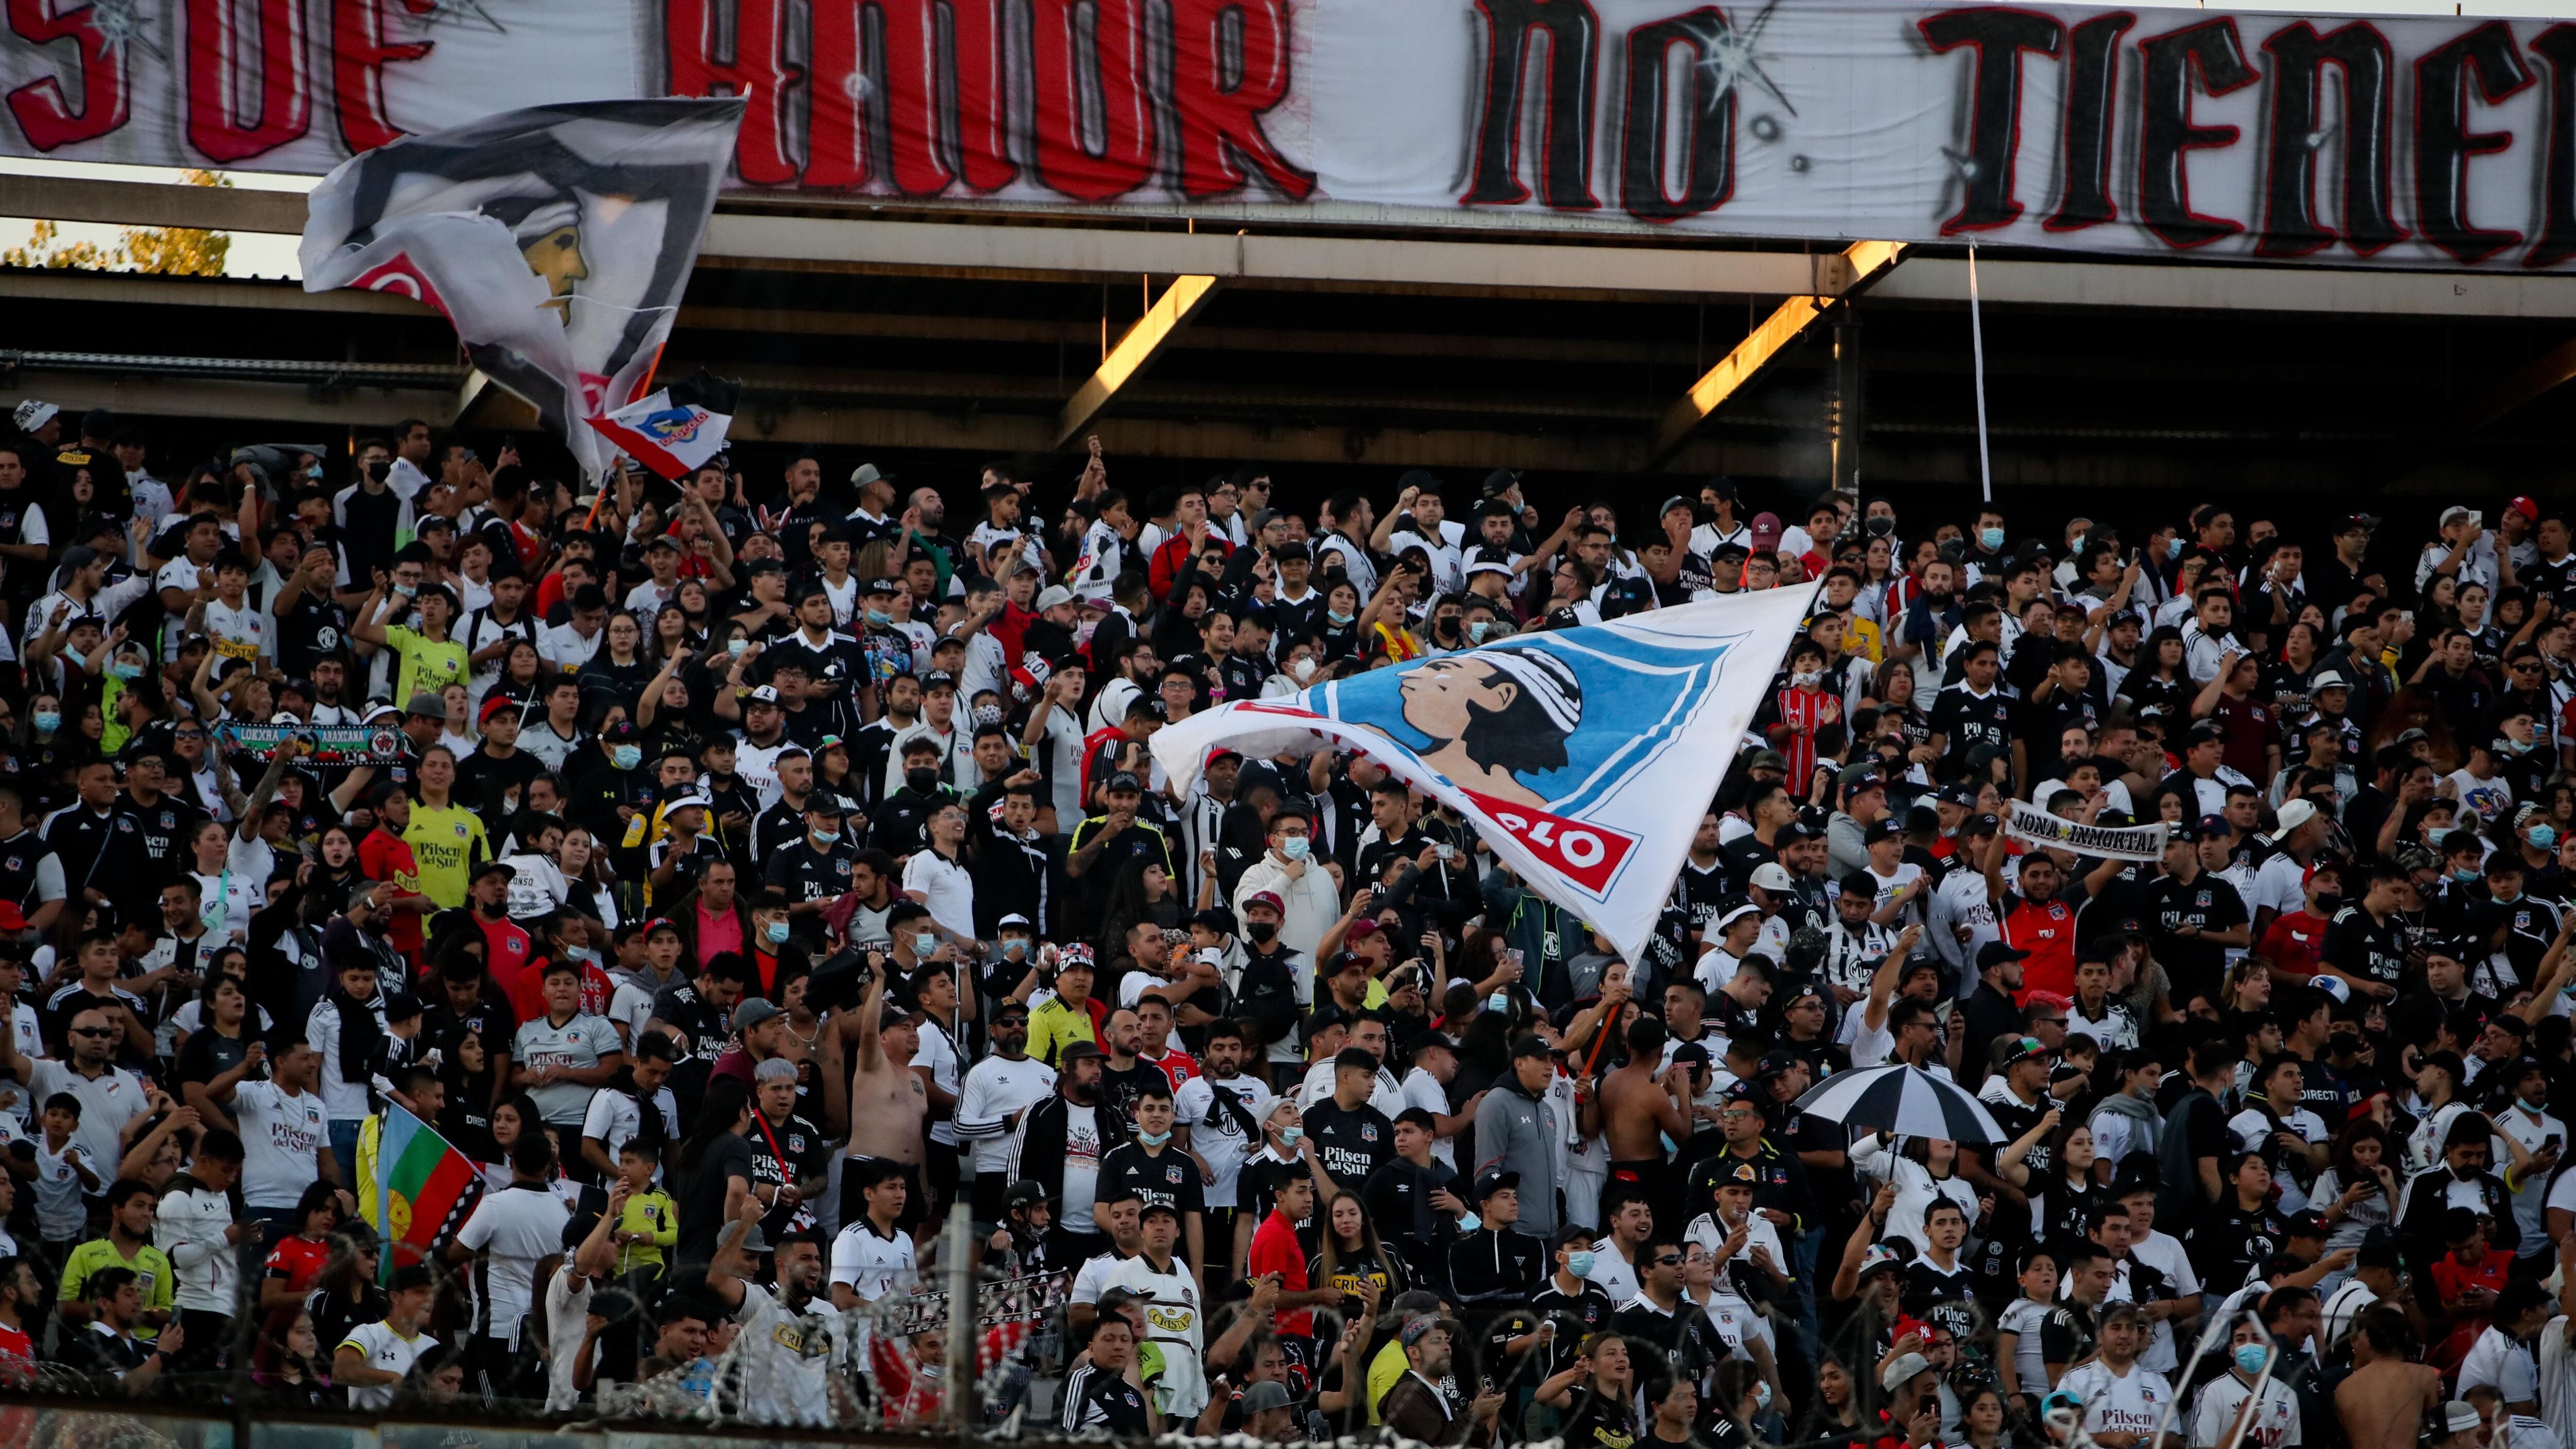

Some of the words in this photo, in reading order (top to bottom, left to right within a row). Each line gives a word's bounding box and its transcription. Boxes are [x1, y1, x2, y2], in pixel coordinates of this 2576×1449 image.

[1462, 0, 1737, 223] NO
[1680, 569, 1710, 584] Pilsen
[1904, 723, 1929, 738] ilsen
[1963, 722, 2001, 737] Pilen
[2012, 810, 2060, 841] JONA
[2070, 825, 2159, 854] INMORTAL
[419, 843, 461, 856] Pilsen
[421, 856, 435, 864] del
[435, 857, 459, 870] Sur
[2161, 910, 2206, 925] Pilen
[1545, 932, 1558, 955] MG
[2368, 951, 2401, 968] Pilsen
[2382, 967, 2400, 979] Sur
[529, 1052, 573, 1065] Pilsen
[2299, 1089, 2339, 1101] DIRECTV
[270, 1123, 315, 1143] Pilsen
[272, 1135, 287, 1147] del
[289, 1139, 312, 1153] Sur
[1324, 1146, 1370, 1164] Pilsen
[752, 1154, 796, 1174] Pilsn
[1327, 1160, 1342, 1170] del
[1342, 1160, 1369, 1175] Sur
[1989, 1241, 2003, 1254] MG
[1332, 1277, 1387, 1290] CRISAL
[1919, 1325, 1931, 1338] NY
[2102, 1409, 2151, 1426] Pilsen
